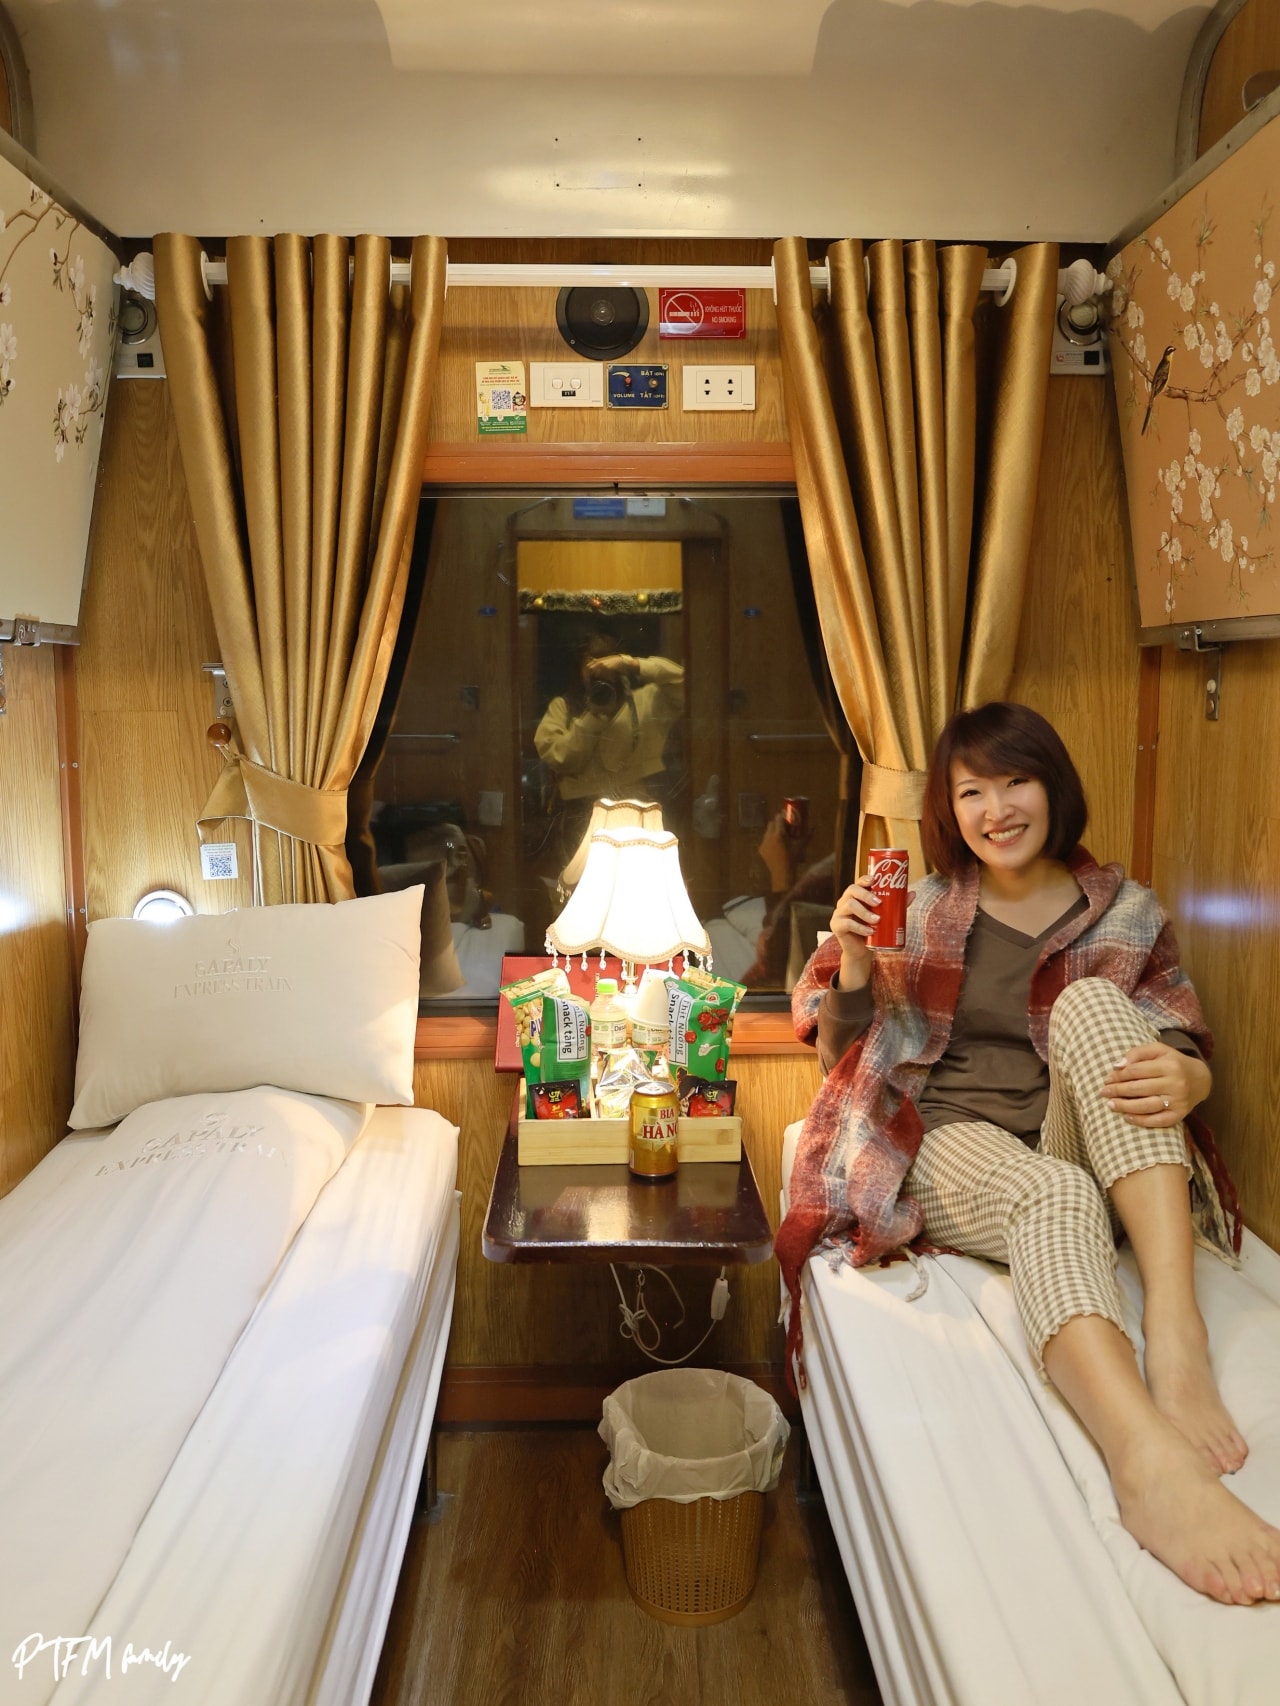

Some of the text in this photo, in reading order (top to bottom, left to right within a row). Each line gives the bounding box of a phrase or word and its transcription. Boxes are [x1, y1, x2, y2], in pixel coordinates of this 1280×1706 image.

[561, 1000, 573, 1028] nack
[660, 1108, 675, 1120] BIA
[643, 1121, 665, 1139] HÀ
